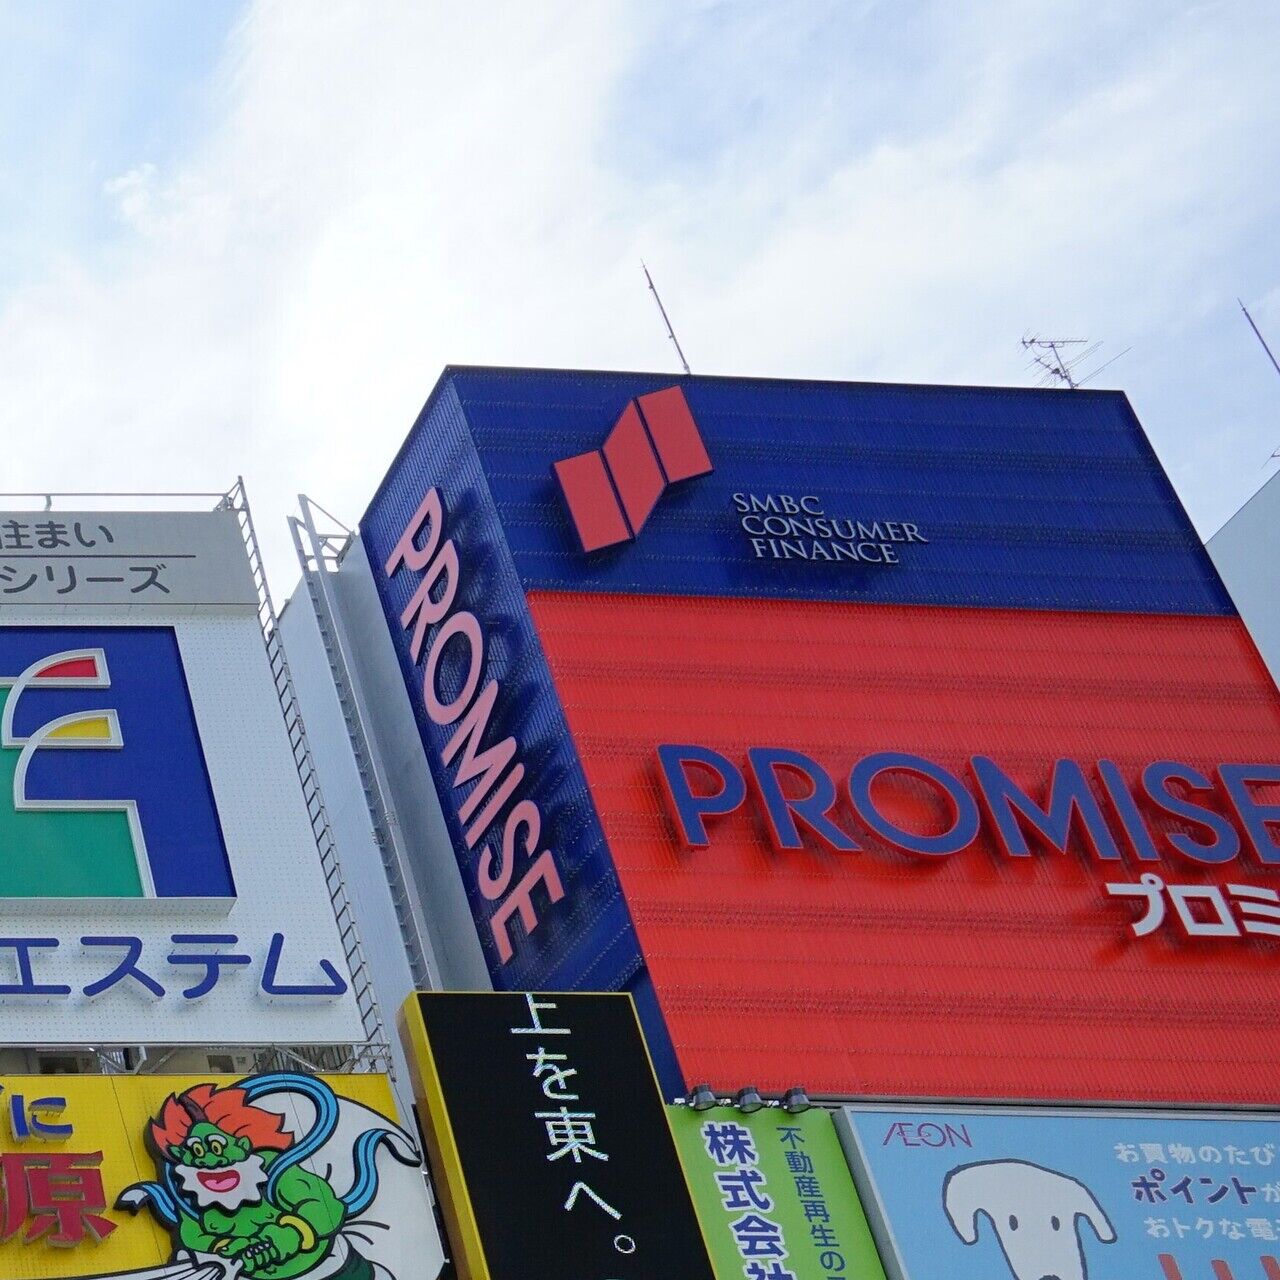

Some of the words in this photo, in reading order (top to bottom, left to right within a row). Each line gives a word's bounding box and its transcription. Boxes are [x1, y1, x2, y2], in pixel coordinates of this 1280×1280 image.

[732, 491, 822, 517] SMBC
[740, 513, 931, 547] CONSUMER
[751, 537, 903, 567] FINANCE
[385, 485, 565, 967] PROMISE
[657, 742, 1280, 867] PROMISE
[1143, 1216, 1280, 1241] おトクな電
